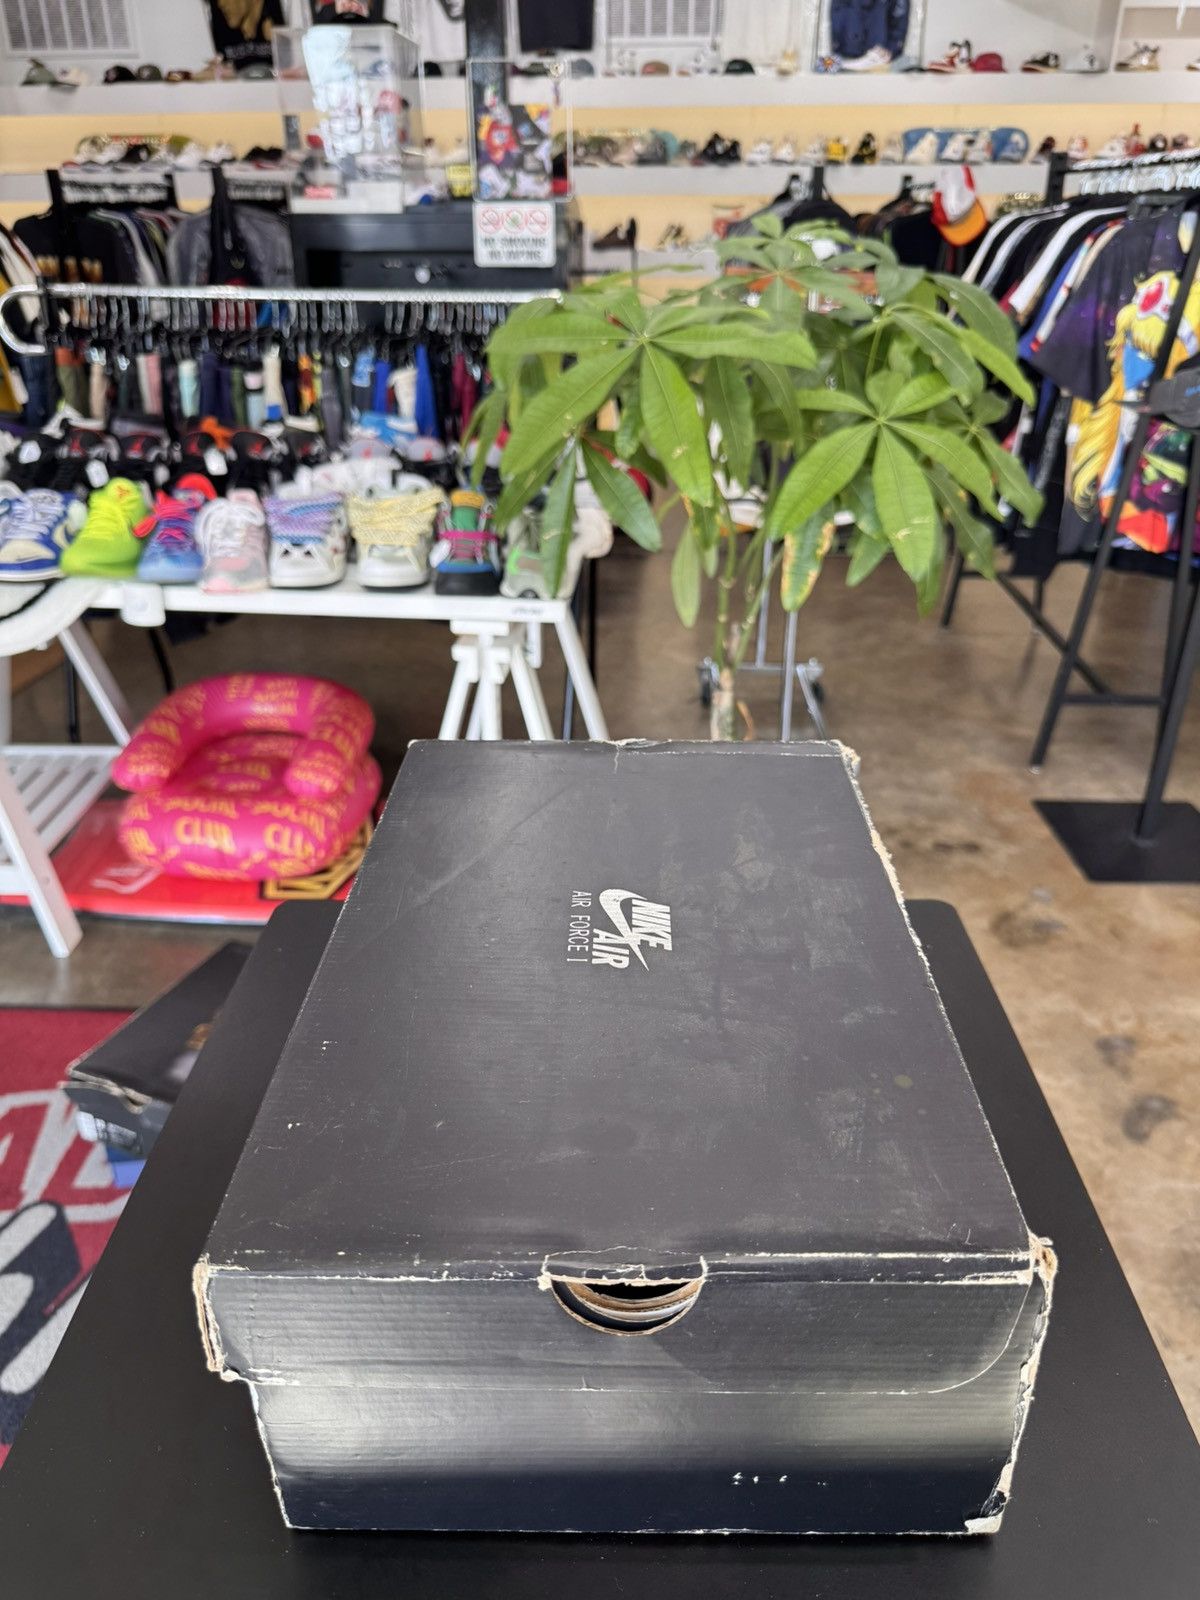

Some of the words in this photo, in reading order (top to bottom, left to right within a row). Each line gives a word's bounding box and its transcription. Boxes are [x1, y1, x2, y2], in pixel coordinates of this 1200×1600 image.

[572, 890, 592, 907] AIR
[567, 915, 590, 952] FORCE
[632, 899, 672, 951] NIKE
[592, 928, 629, 968] AIR
